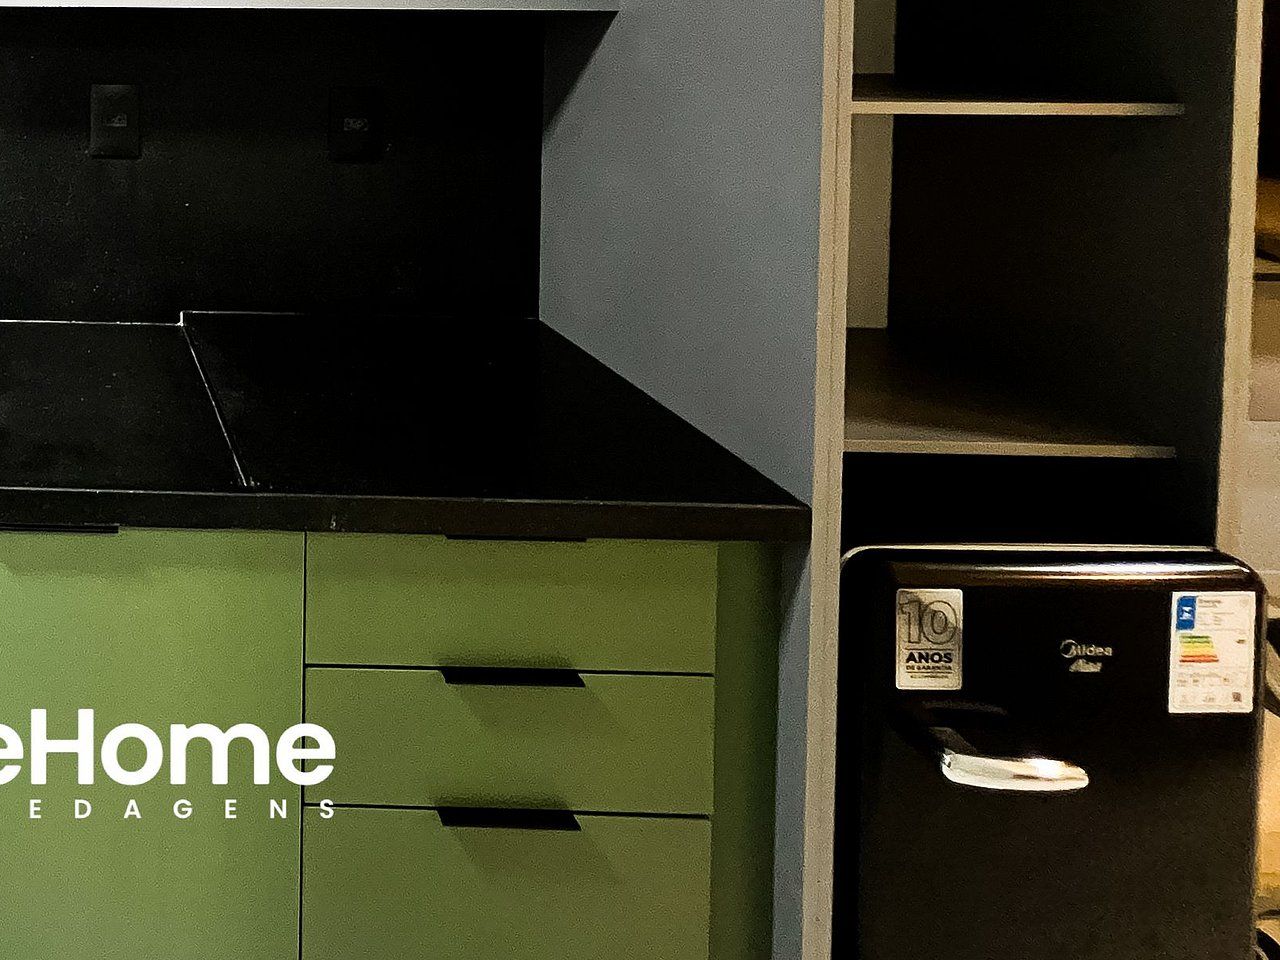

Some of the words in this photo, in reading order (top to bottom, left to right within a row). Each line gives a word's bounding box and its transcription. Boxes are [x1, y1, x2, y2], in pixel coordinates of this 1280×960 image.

[898, 599, 959, 645] 10
[905, 651, 954, 664] ANOS
[1059, 639, 1113, 658] Midea
